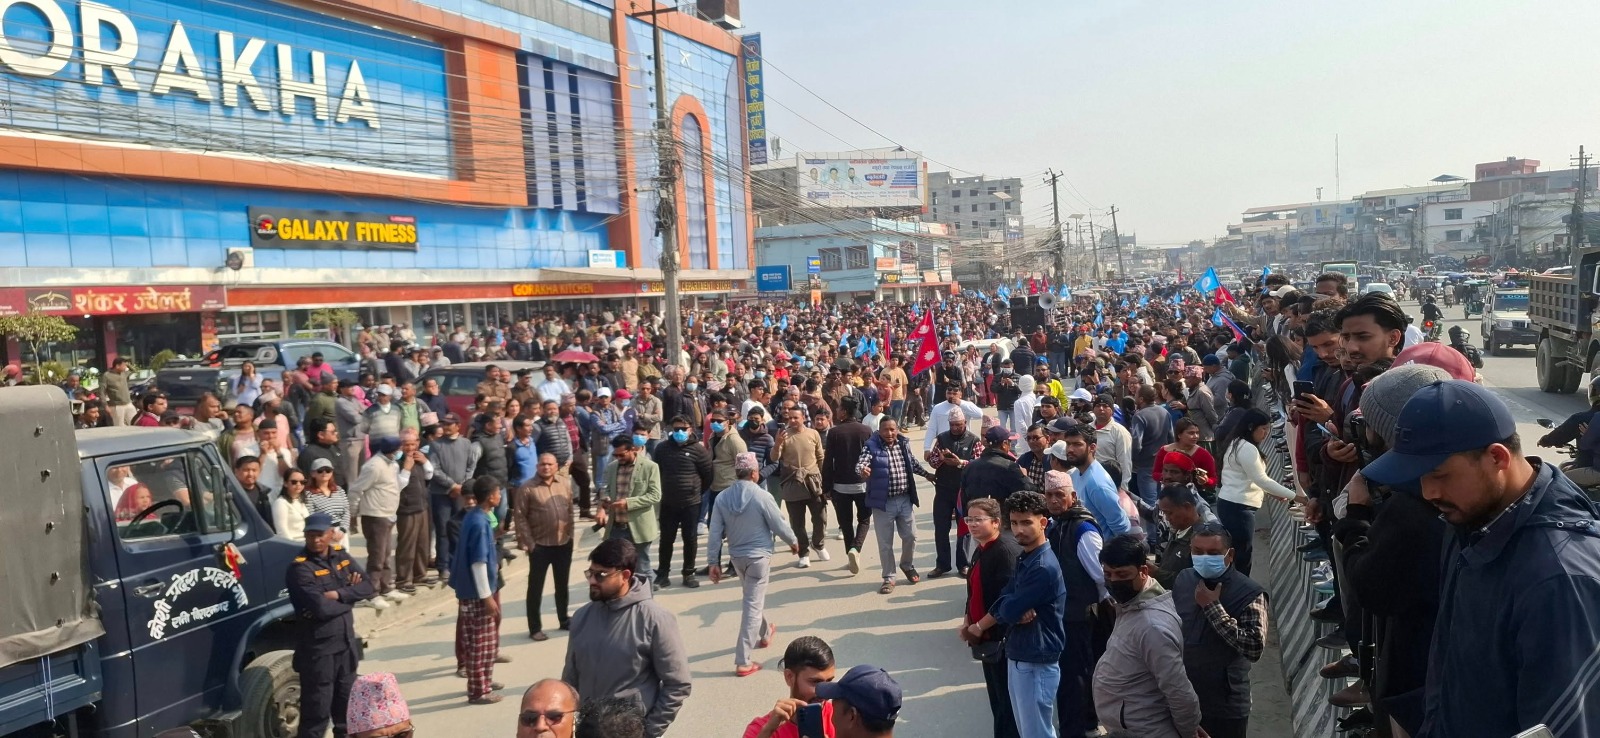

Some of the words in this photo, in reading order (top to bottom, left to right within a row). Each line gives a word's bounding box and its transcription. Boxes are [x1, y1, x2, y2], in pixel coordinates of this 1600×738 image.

[278, 218, 350, 241] GALAXY
[356, 222, 416, 243] FITNESS
[512, 283, 558, 296] GORAKHA
[559, 282, 594, 295] KITCHEN
[651, 282, 666, 292] GOR
[681, 281, 713, 291] DEPARTMENT
[716, 280, 731, 290] STORE
[75, 289, 128, 312] शंकर
[165, 568, 200, 602] प्रदेश
[202, 566, 238, 589] प्रहरी
